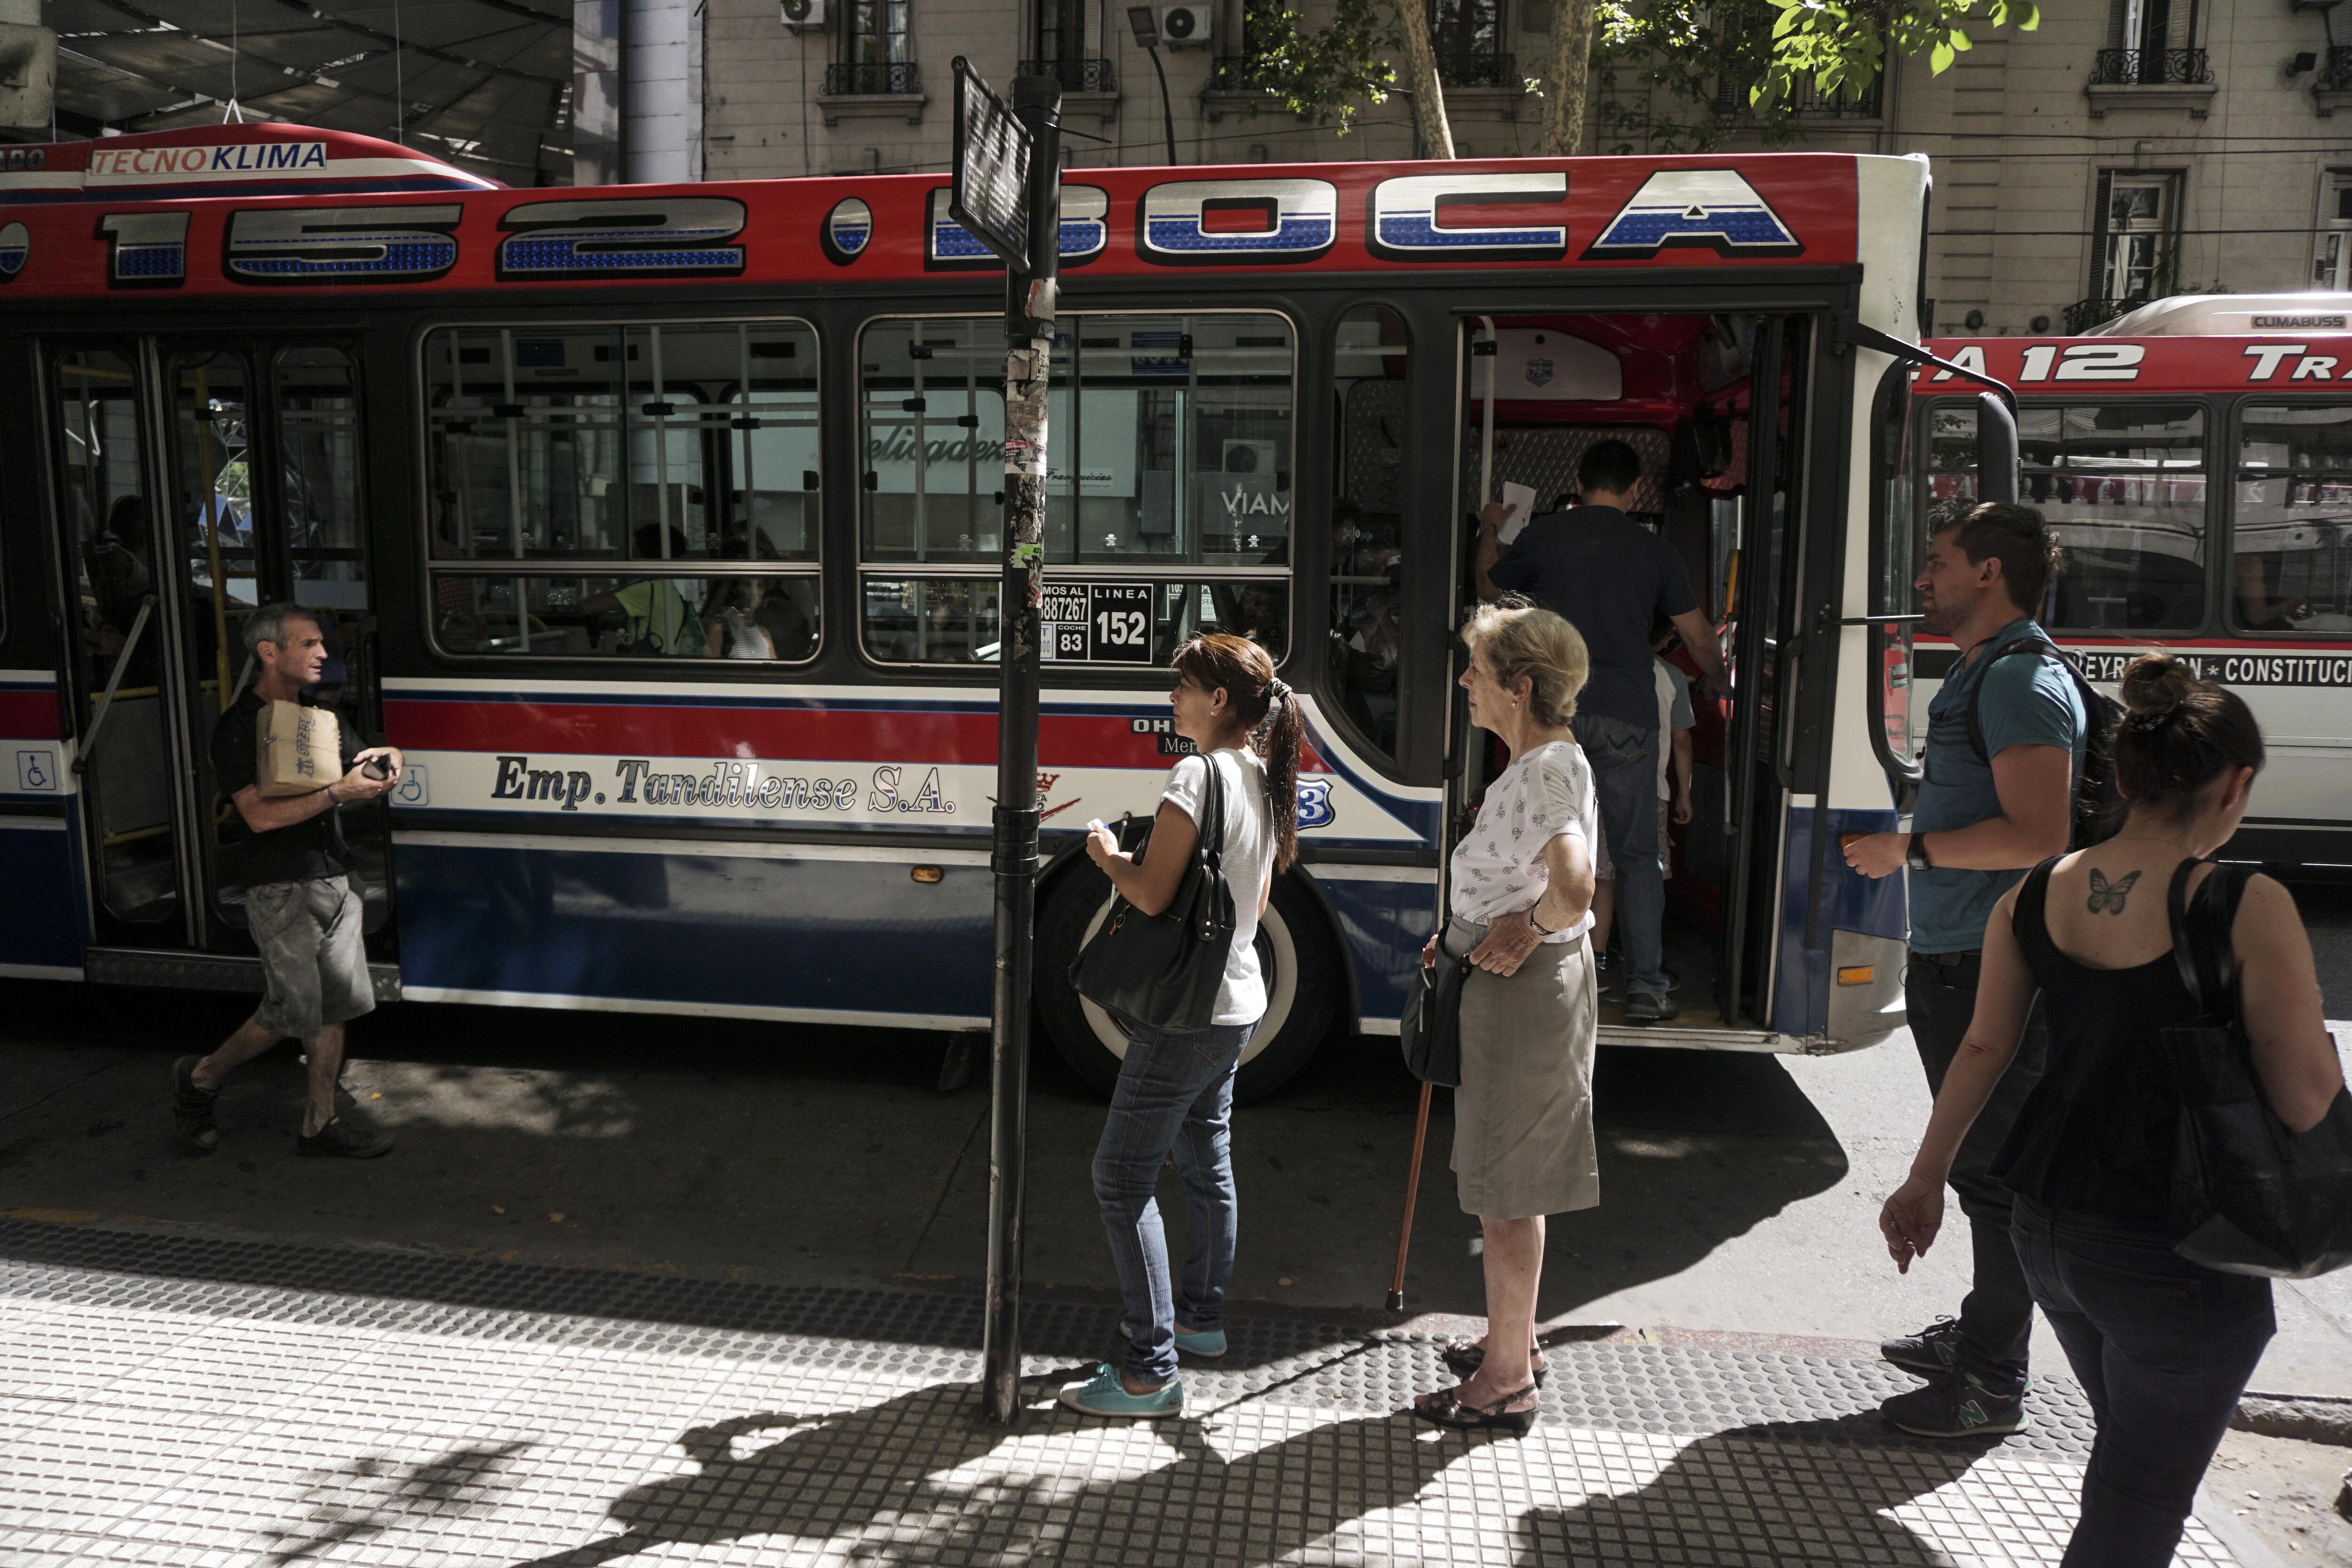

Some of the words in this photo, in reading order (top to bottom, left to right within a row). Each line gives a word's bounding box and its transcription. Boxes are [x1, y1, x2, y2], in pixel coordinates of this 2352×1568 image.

[924, 168, 1805, 271] BOCA
[2254, 316, 2344, 327] CLIMABUSS
[2018, 344, 2145, 382] 12
[1095, 589, 1148, 599] LINEA
[1097, 611, 1146, 645] 152
[1041, 640, 1050, 653] 00
[1060, 634, 1082, 651] 83
[2225, 658, 2352, 683] CONSTITUCI
[491, 756, 605, 810] Emp.
[617, 758, 858, 811] Tandilense
[868, 765, 956, 813] S.A.
[1298, 789, 1325, 819] 3
